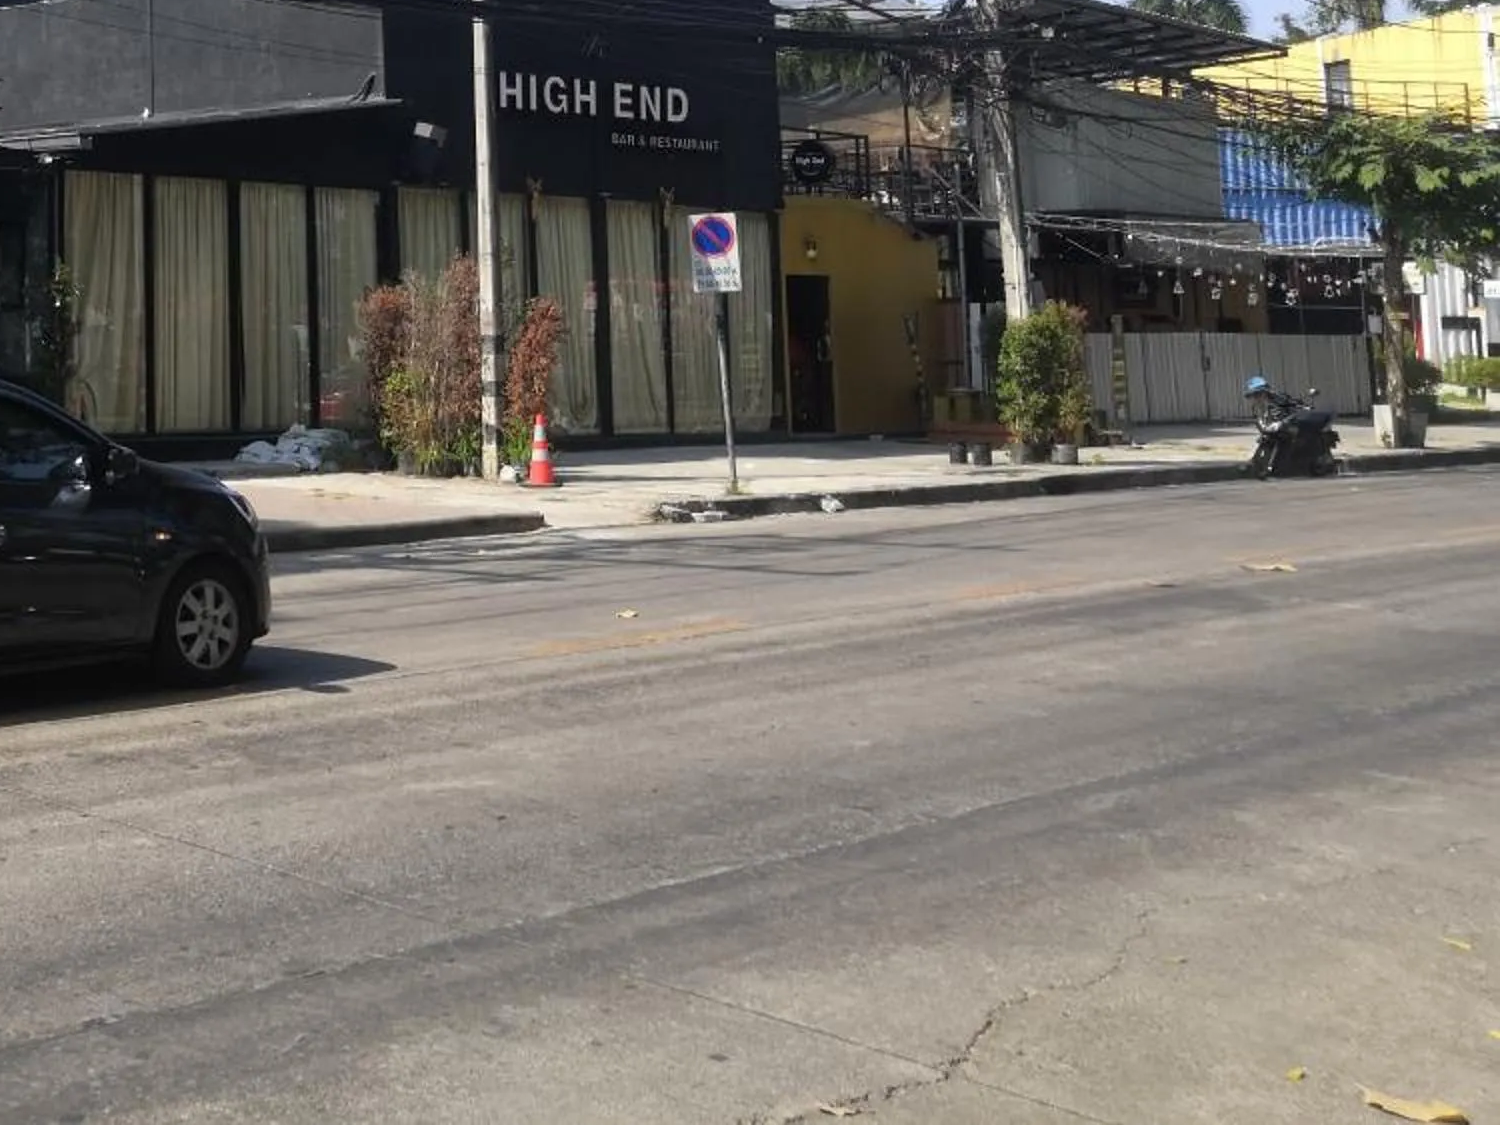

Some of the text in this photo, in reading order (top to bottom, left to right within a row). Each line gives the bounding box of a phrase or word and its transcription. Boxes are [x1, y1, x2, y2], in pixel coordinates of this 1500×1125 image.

[499, 71, 689, 123] HIGH END
[611, 132, 635, 147] BAR
[649, 135, 721, 152] RESTAURANT
